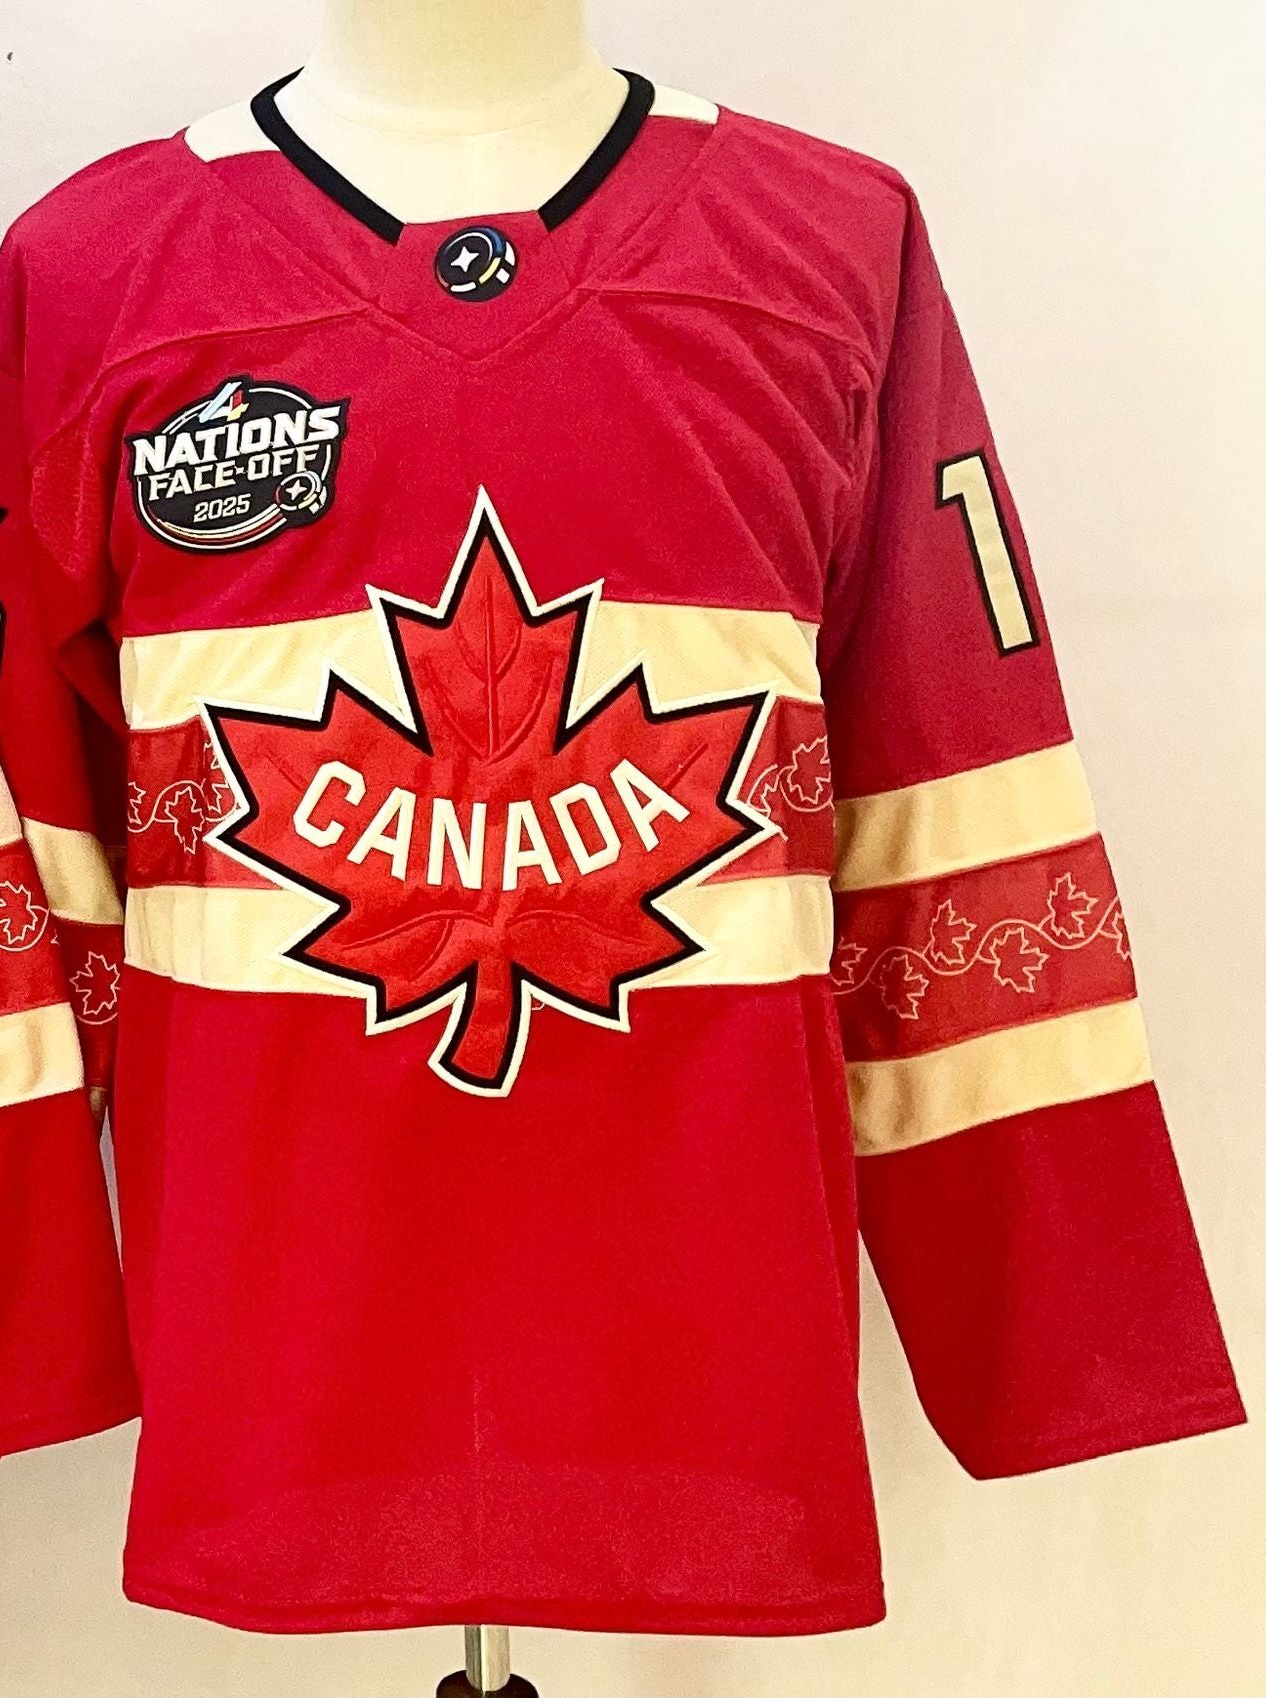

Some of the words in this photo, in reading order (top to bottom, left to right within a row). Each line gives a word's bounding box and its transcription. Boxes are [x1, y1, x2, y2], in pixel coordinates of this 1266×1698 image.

[133, 405, 341, 476] NATIONS
[148, 443, 320, 501] FACE-OFF
[193, 493, 252, 523] 2025
[935, 449, 1041, 659] 1
[292, 758, 691, 892] CANADA
